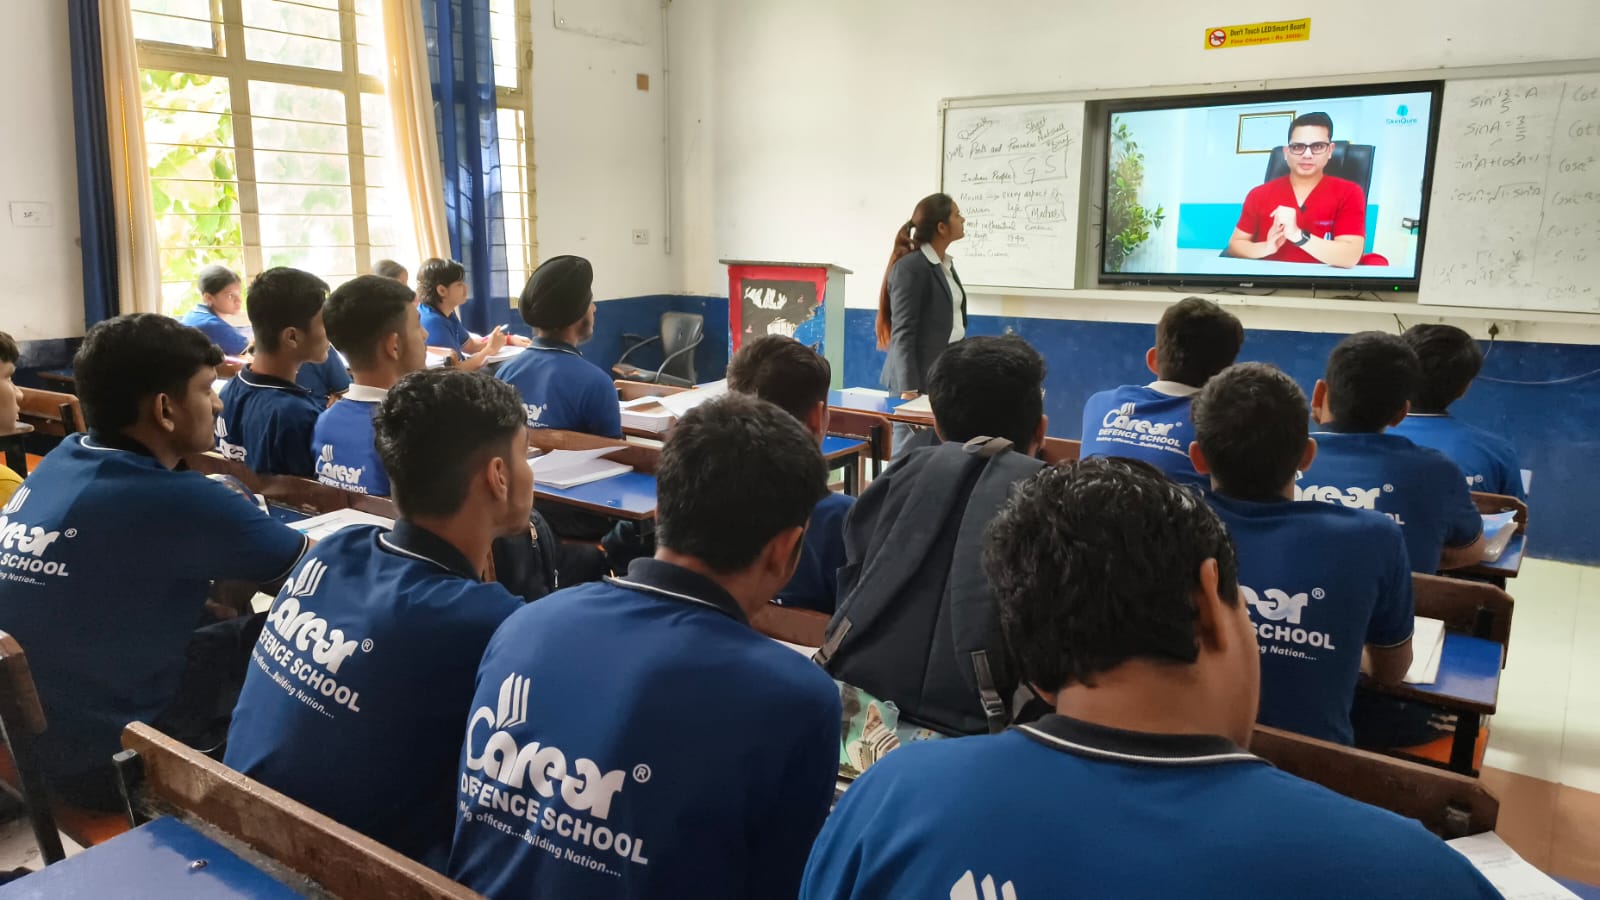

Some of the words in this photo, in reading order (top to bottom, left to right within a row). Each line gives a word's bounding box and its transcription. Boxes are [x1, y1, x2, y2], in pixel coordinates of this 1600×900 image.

[1245, 27, 1260, 35] Touch
[1290, 22, 1306, 31] Board
[1098, 428, 1139, 440] DEFENCE
[1139, 433, 1182, 448] SCHOOL
[0, 552, 70, 577] SCHOOL
[258, 624, 295, 668] EFENCE
[289, 657, 361, 713] SCHOOL
[539, 806, 650, 866] SCHOOL
